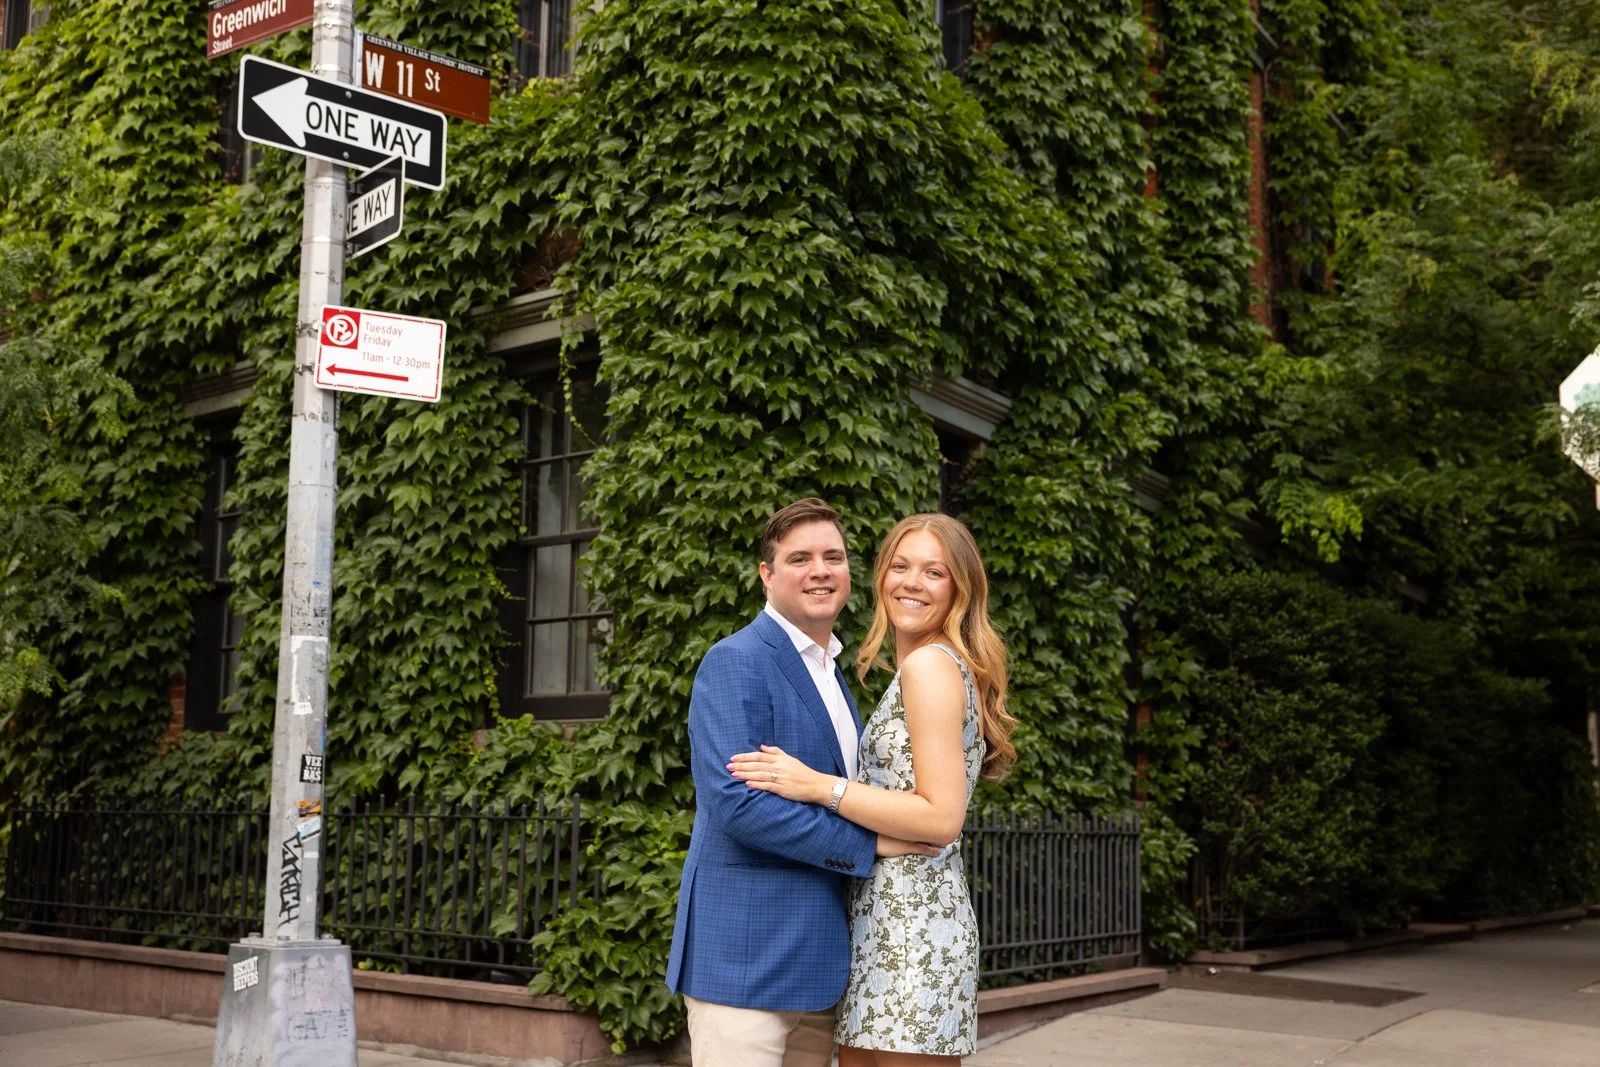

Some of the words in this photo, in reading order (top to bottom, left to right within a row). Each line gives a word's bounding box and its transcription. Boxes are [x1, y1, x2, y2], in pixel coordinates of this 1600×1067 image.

[212, 35, 233, 54] Street
[366, 34, 403, 51] GREENWICH
[403, 44, 429, 60] VILLAGE
[430, 52, 458, 68] HISTORIC
[457, 62, 484, 76] DISTRICT
[365, 50, 385, 88] W
[397, 60, 414, 98] 11
[425, 68, 441, 93] St
[306, 101, 359, 142] ONE
[370, 118, 423, 158] WAY
[364, 184, 391, 226] WAY
[363, 334, 392, 348] Friday
[365, 321, 403, 337] Tuesday
[362, 352, 384, 363] 11am
[393, 356, 430, 369] 12:30pm
